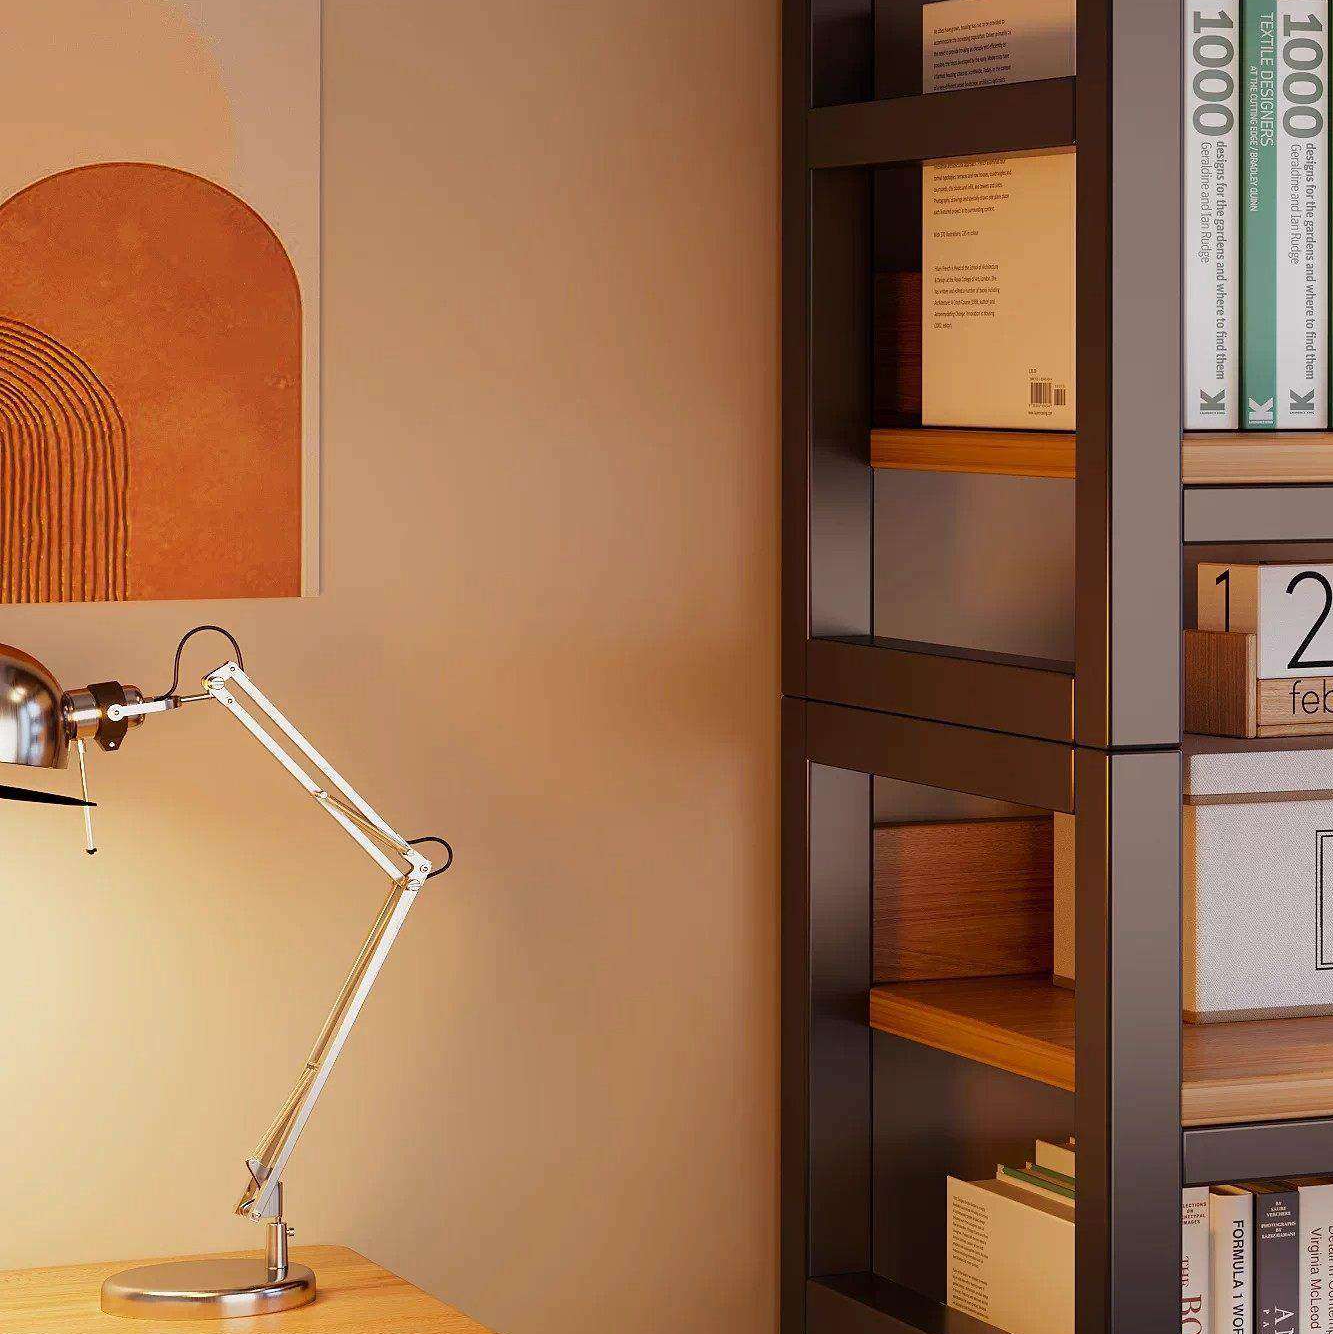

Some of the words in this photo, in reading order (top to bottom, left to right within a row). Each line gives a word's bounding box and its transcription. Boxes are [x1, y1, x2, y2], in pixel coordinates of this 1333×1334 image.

[1192, 11, 1234, 137] 1000
[1283, 14, 1323, 138] 1000
[1215, 568, 1231, 632] 1
